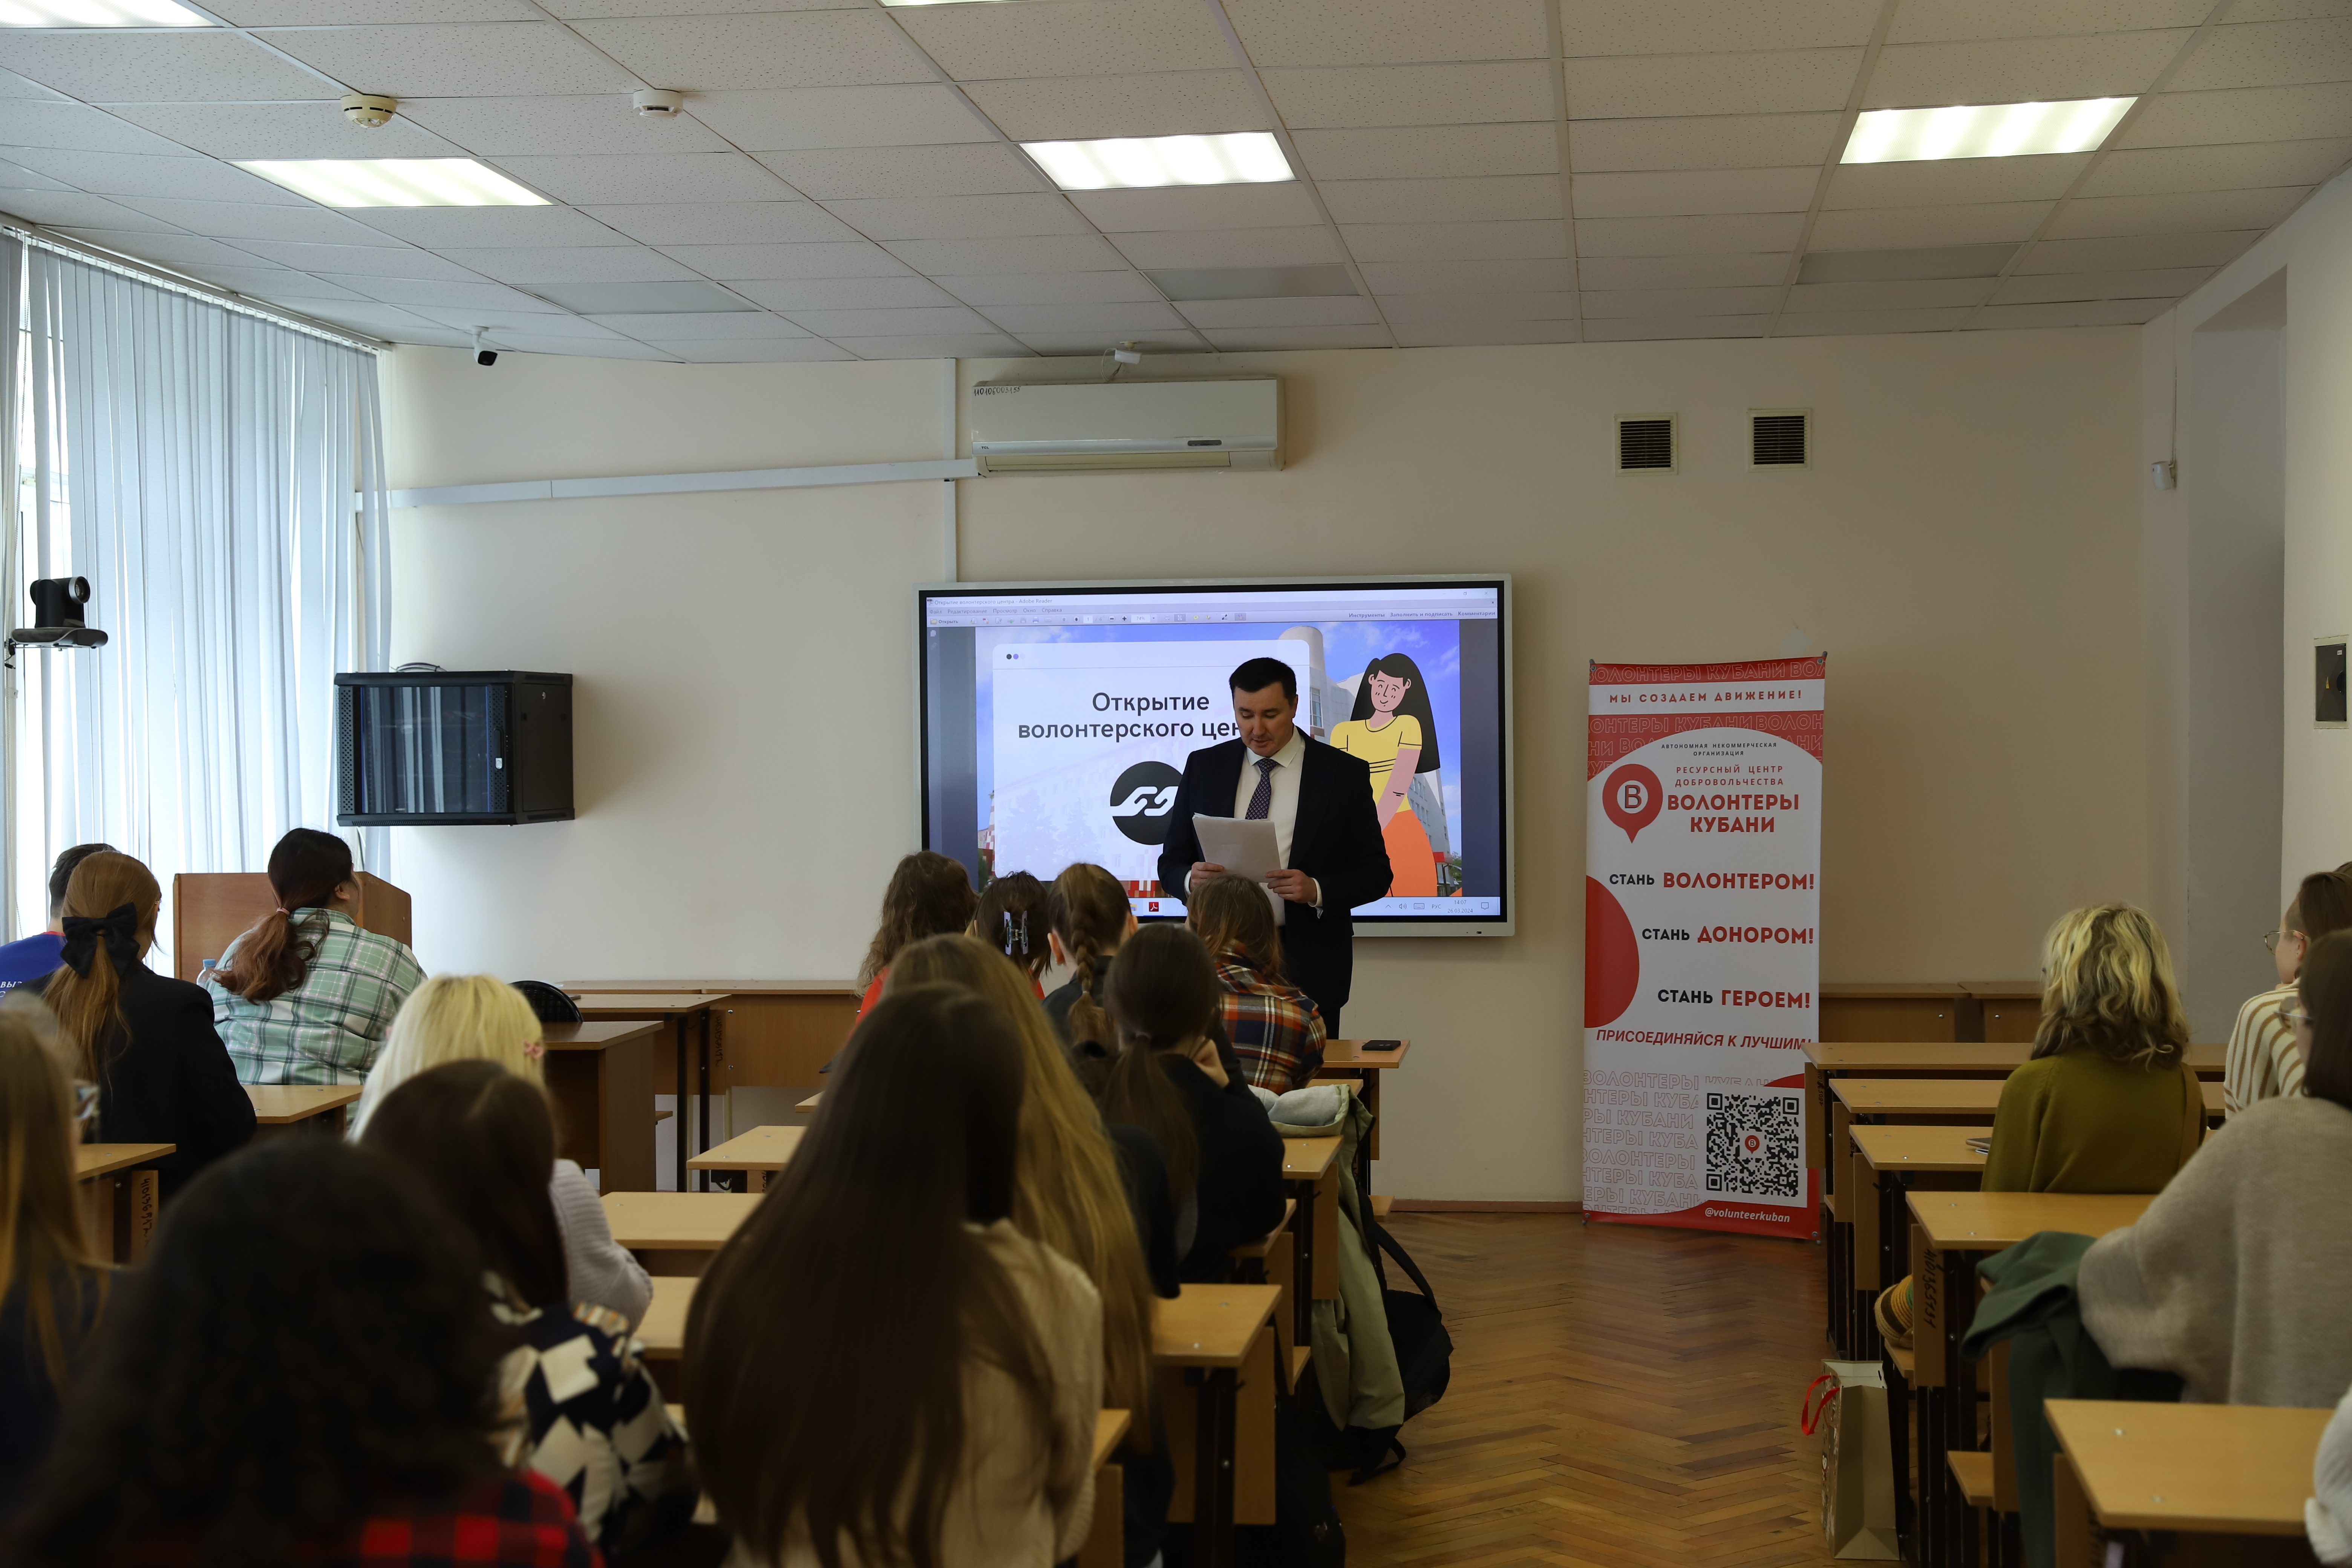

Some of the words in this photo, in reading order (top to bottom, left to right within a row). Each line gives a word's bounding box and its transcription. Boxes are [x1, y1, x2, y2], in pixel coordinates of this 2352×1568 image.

[1706, 663, 1785, 680] КУБАНИ
[1092, 692, 1209, 717] Открытие
[1609, 694, 1631, 703] МЫ
[1639, 692, 1707, 703] СОЗДАЕМ
[1714, 690, 1801, 702] ДВИЖЕНИЕ!
[1018, 723, 1194, 743] волонтерского
[1588, 718, 1669, 733] ОНТЕРЫ
[1676, 764, 1740, 774] РЕСУРСНЫЙ
[1748, 766, 1783, 775] ЦЕНТР
[1675, 778, 1784, 788] ДОБРОВОЛЬЧЕСТВА
[1668, 794, 1799, 811] ВОЛОНТЕРЫ
[1690, 817, 1775, 833] КУБАНИ
[1609, 874, 1655, 885] СТАНЬ
[1663, 872, 1814, 890] ВОЛОНТЕРОМ!
[1642, 928, 1690, 941] СТАНЬ
[1697, 926, 1814, 944] ДОНОРОМ!
[1658, 989, 1713, 1004] СТАНЬ
[1721, 990, 1810, 1008] ГЕРОЕМ!
[1596, 1029, 1724, 1046] ПРИСОЕДИНЯЙСЯ
[1727, 1035, 1738, 1047] К
[1617, 1110, 1693, 1129] КУБАНИ
[1705, 1207, 1790, 1223] @volunteerkuban
